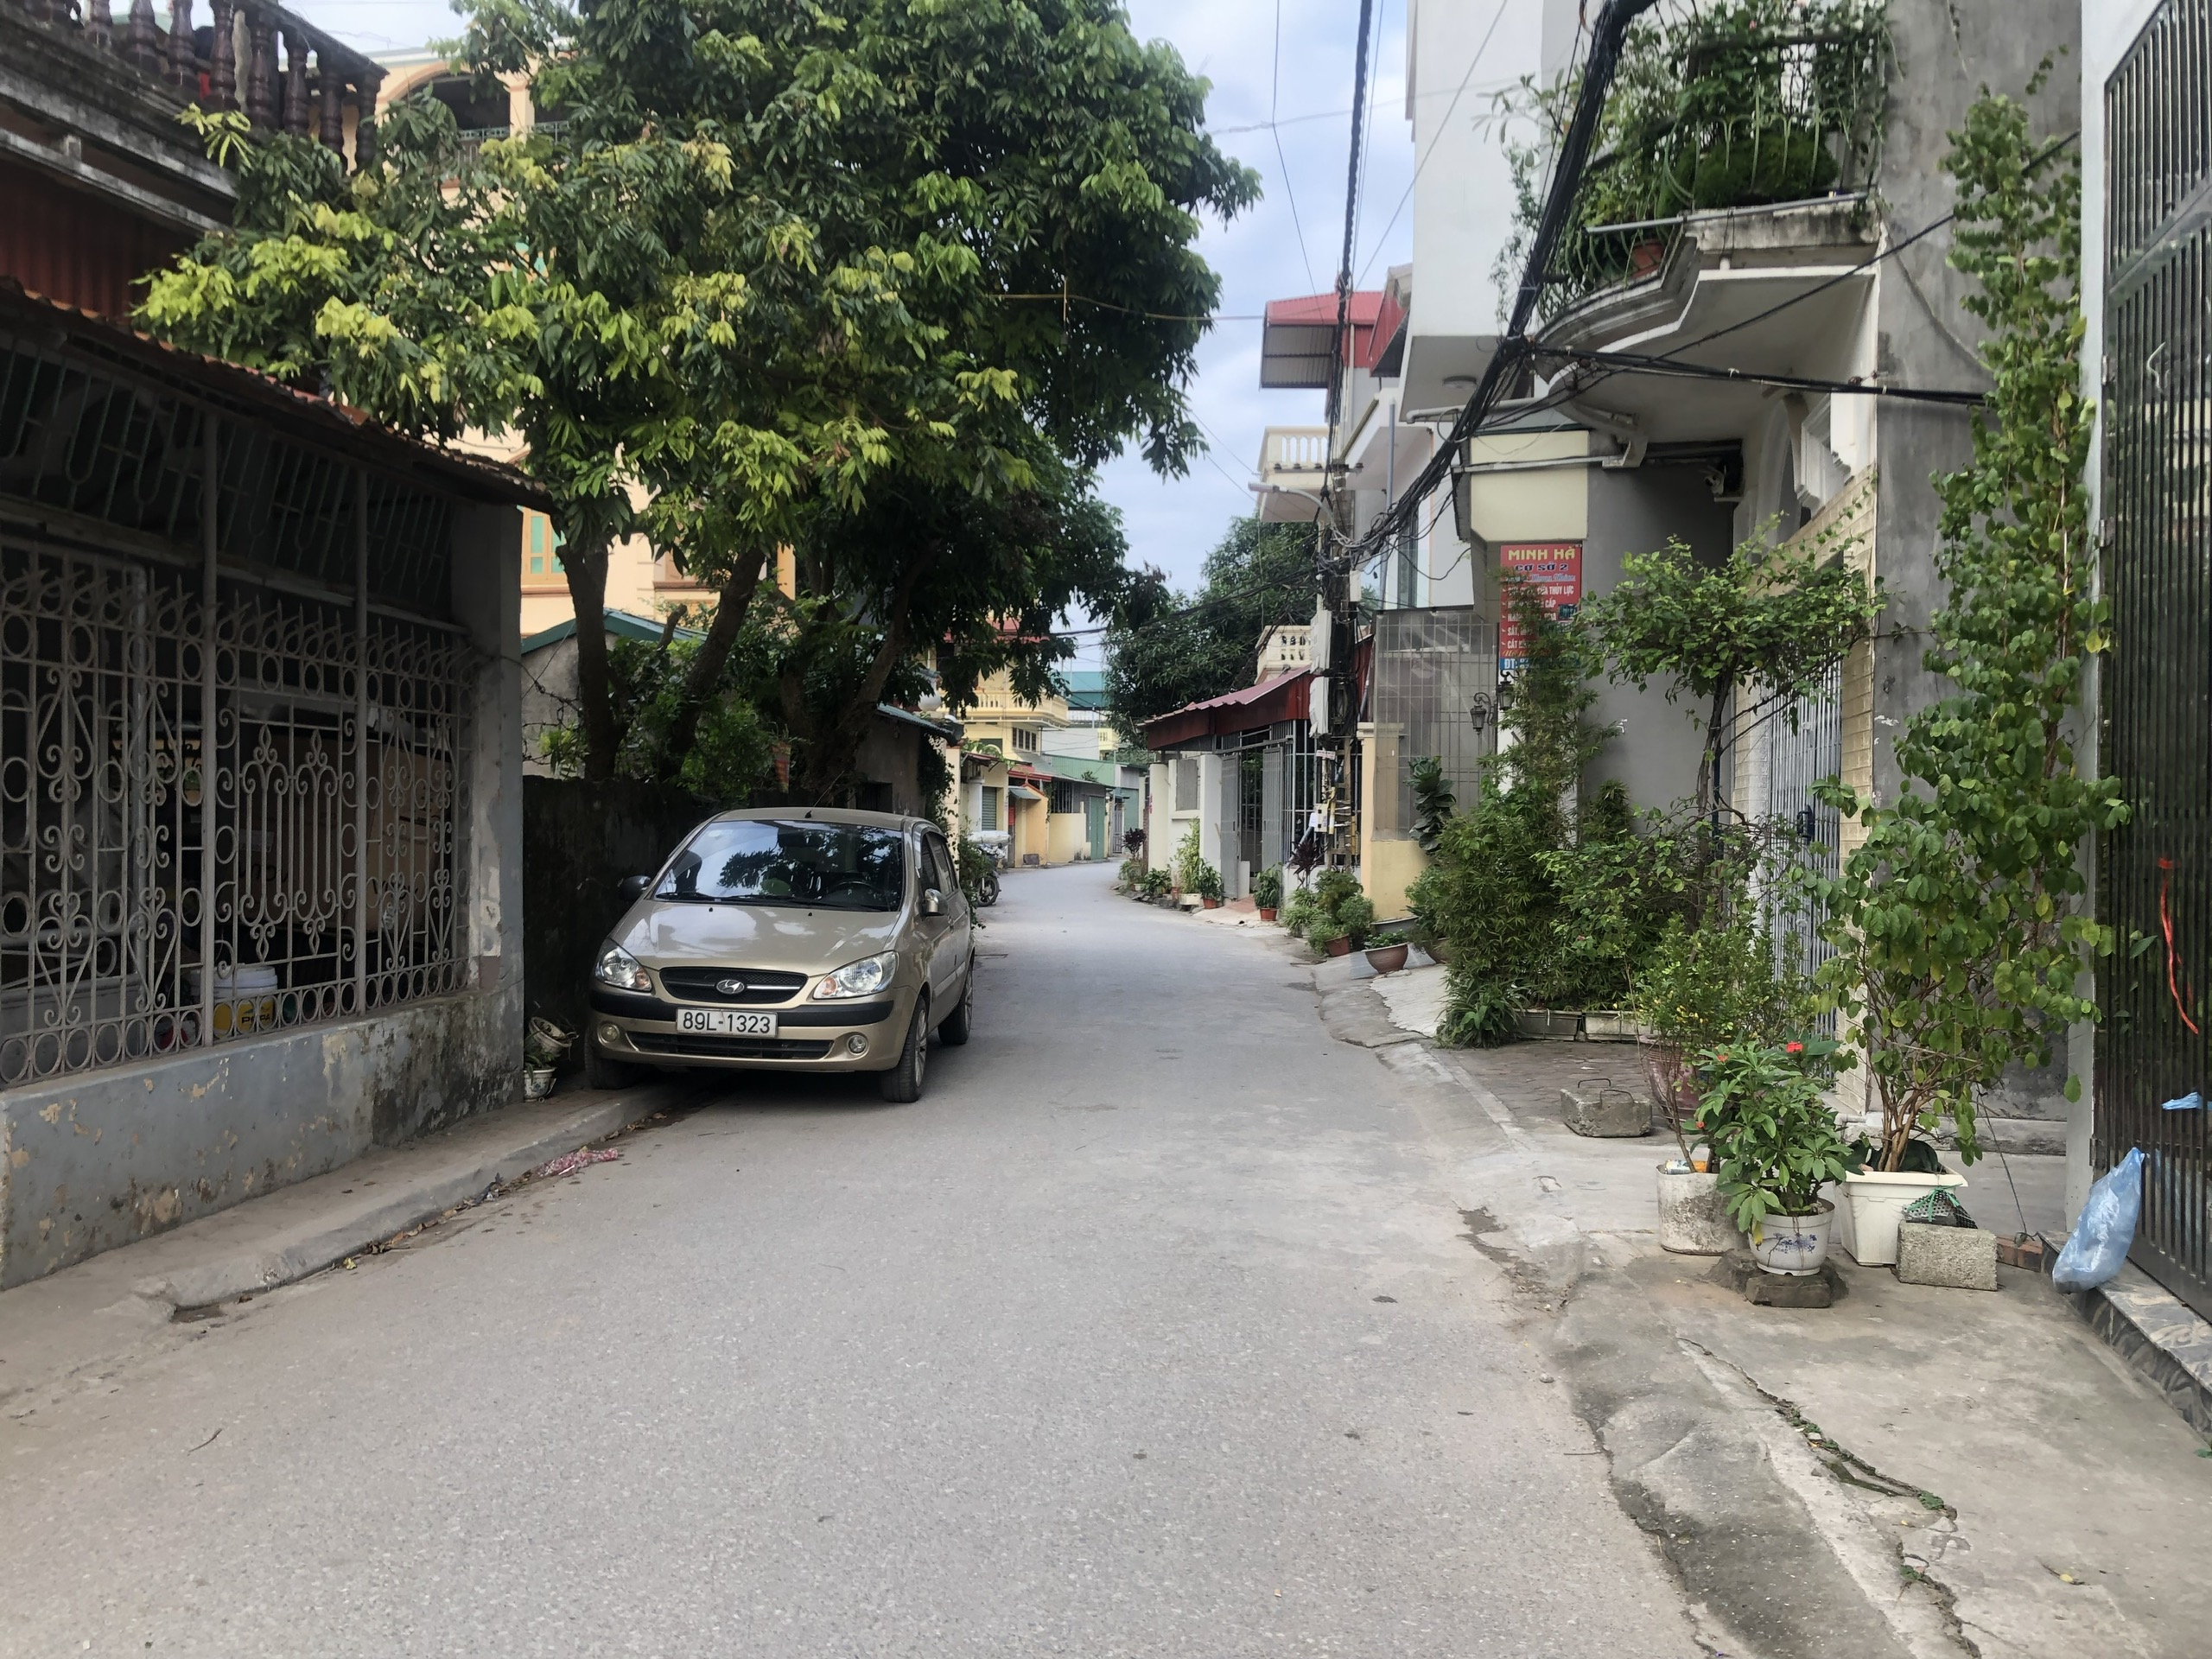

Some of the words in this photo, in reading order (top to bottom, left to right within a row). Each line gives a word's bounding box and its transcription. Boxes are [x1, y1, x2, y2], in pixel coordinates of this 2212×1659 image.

[1508, 549, 1548, 561] MINH
[1554, 546, 1575, 560] HÀ
[683, 1012, 771, 1033] 89L-1323
